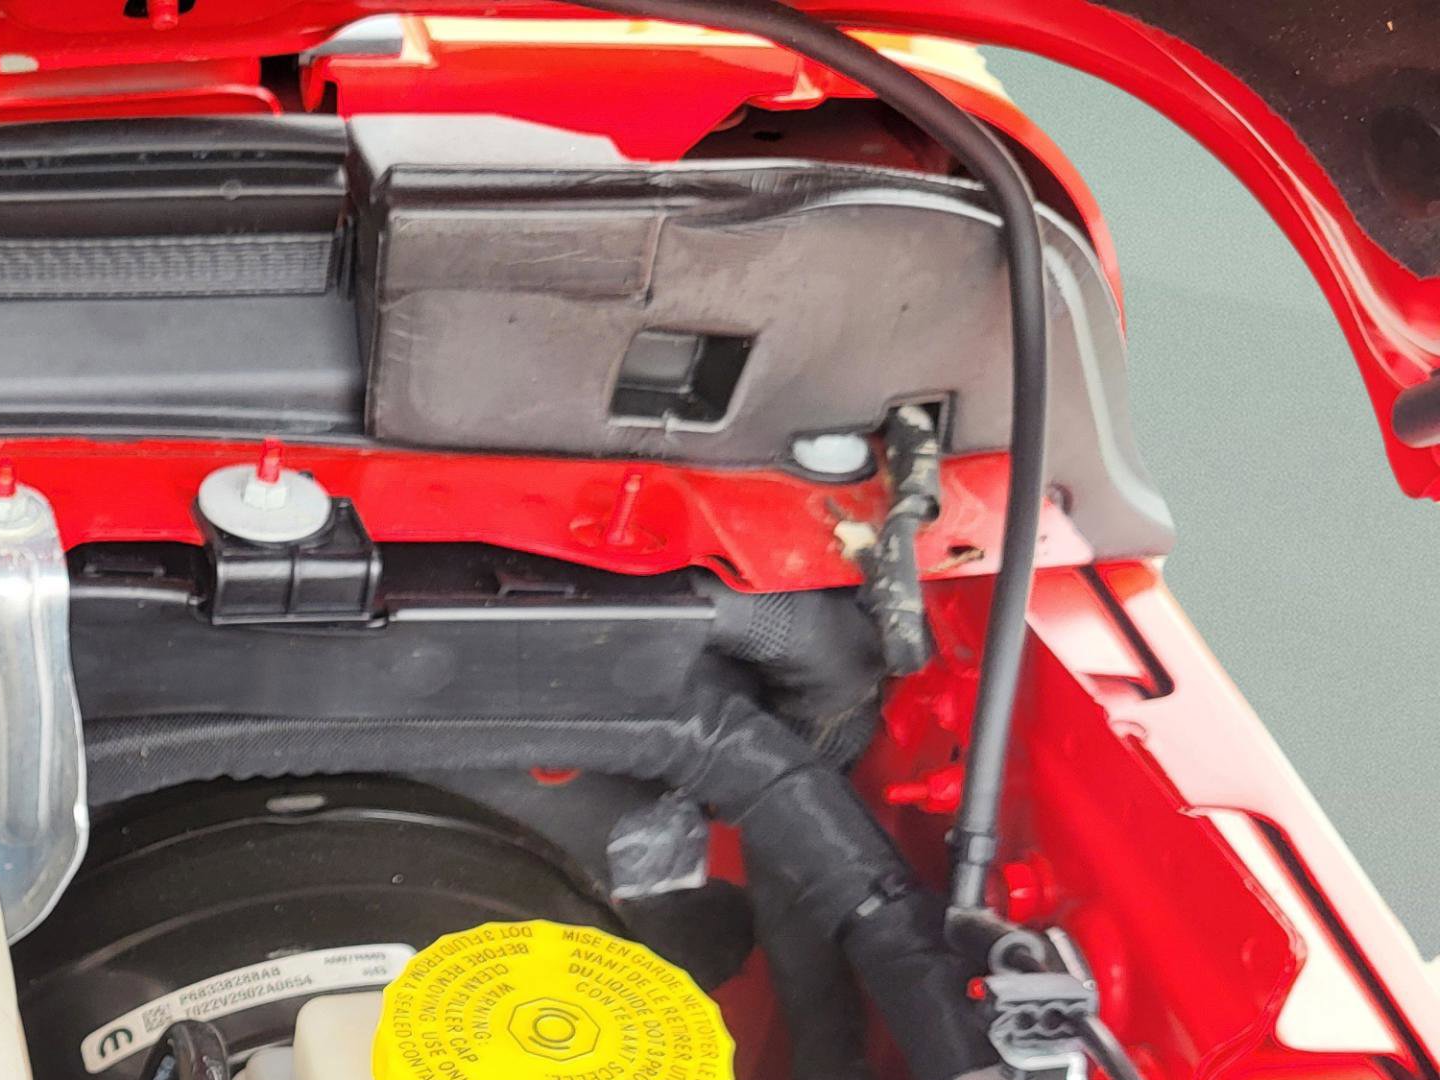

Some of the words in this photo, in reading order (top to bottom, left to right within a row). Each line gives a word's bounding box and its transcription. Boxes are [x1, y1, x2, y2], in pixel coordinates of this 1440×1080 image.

[483, 930, 496, 941] 3
[500, 926, 533, 938] DOT
[562, 930, 602, 948] MISE
[440, 935, 484, 956] FLUID
[461, 942, 529, 967] BEFORE
[606, 942, 632, 957] EN
[410, 954, 445, 982] FROM
[461, 963, 510, 992] CLEAN
[568, 963, 594, 978] DU
[570, 948, 629, 974] AVANT
[626, 971, 651, 989] DE
[646, 987, 670, 1005] LE
[595, 973, 654, 1017] LIQUIDE
[393, 993, 414, 1038] SEALED
[445, 991, 470, 1033] FILLER
[472, 982, 516, 1046] WARNING:
[643, 1020, 666, 1047] DOT
[681, 994, 720, 1059] NETTOYER
[422, 1032, 447, 1057] USE
[450, 1037, 479, 1063] CAP
[647, 1047, 667, 1057] 3
[700, 1062, 717, 1079] LE
